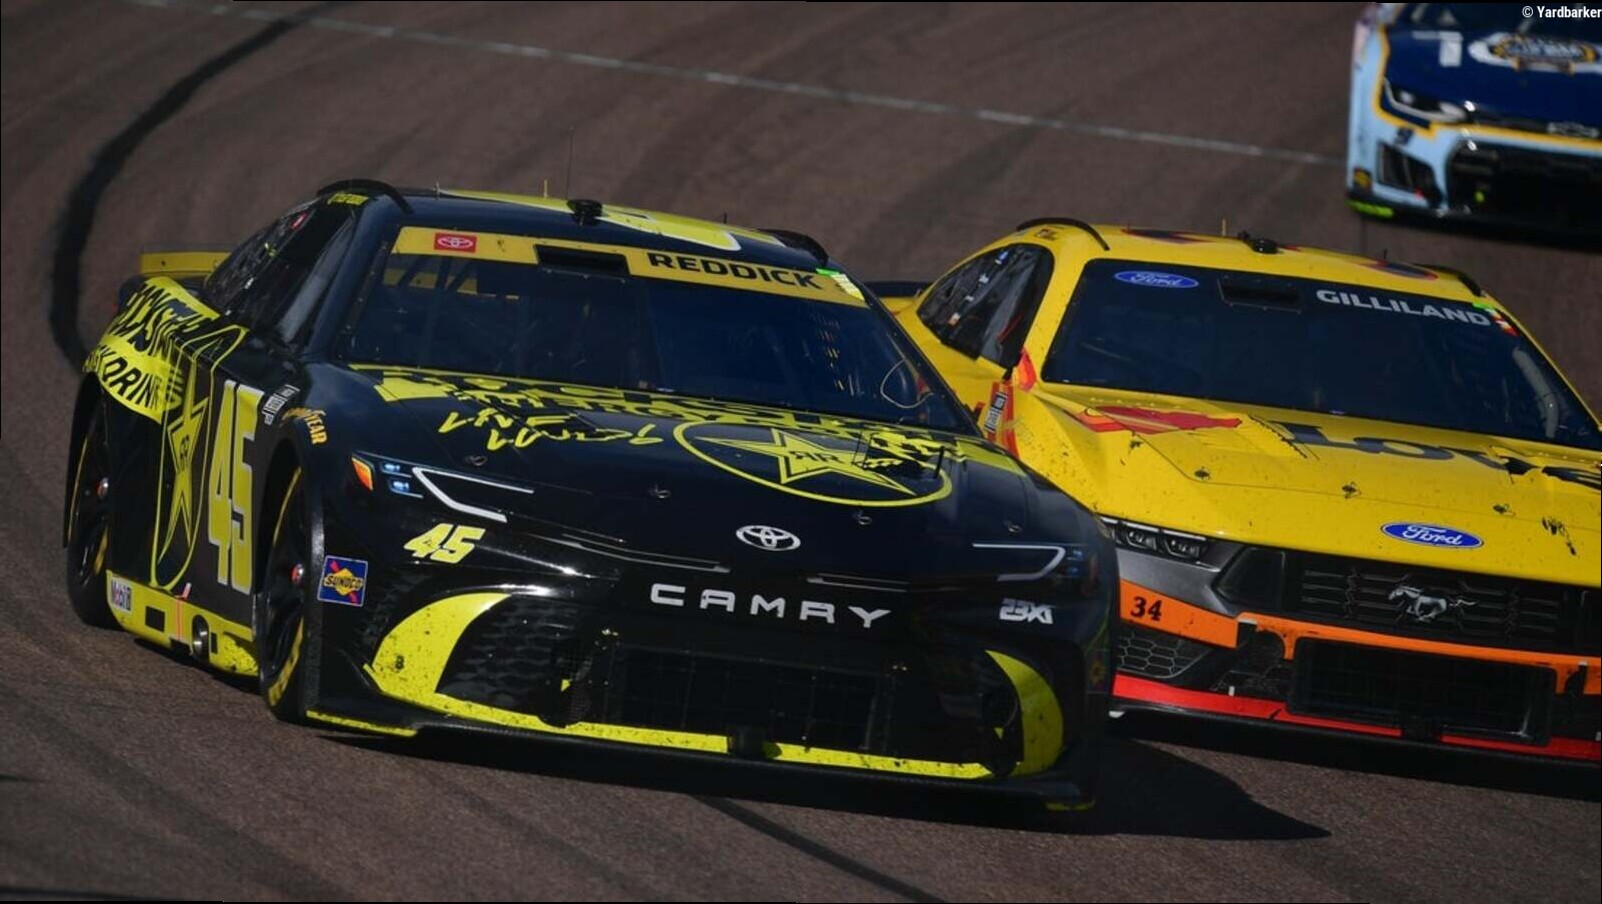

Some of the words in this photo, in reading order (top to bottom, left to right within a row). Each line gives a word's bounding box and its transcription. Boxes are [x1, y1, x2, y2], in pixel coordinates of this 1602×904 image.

[647, 251, 822, 290] REDDICK
[1128, 271, 1184, 288] Ford
[1316, 289, 1492, 326] GILLILAND
[207, 379, 265, 595] 45
[404, 523, 486, 563] 45
[1397, 523, 1467, 548] Ford
[325, 573, 363, 591] SUNOCO
[650, 583, 891, 628] CAMRY
[1129, 596, 1163, 622] 34
